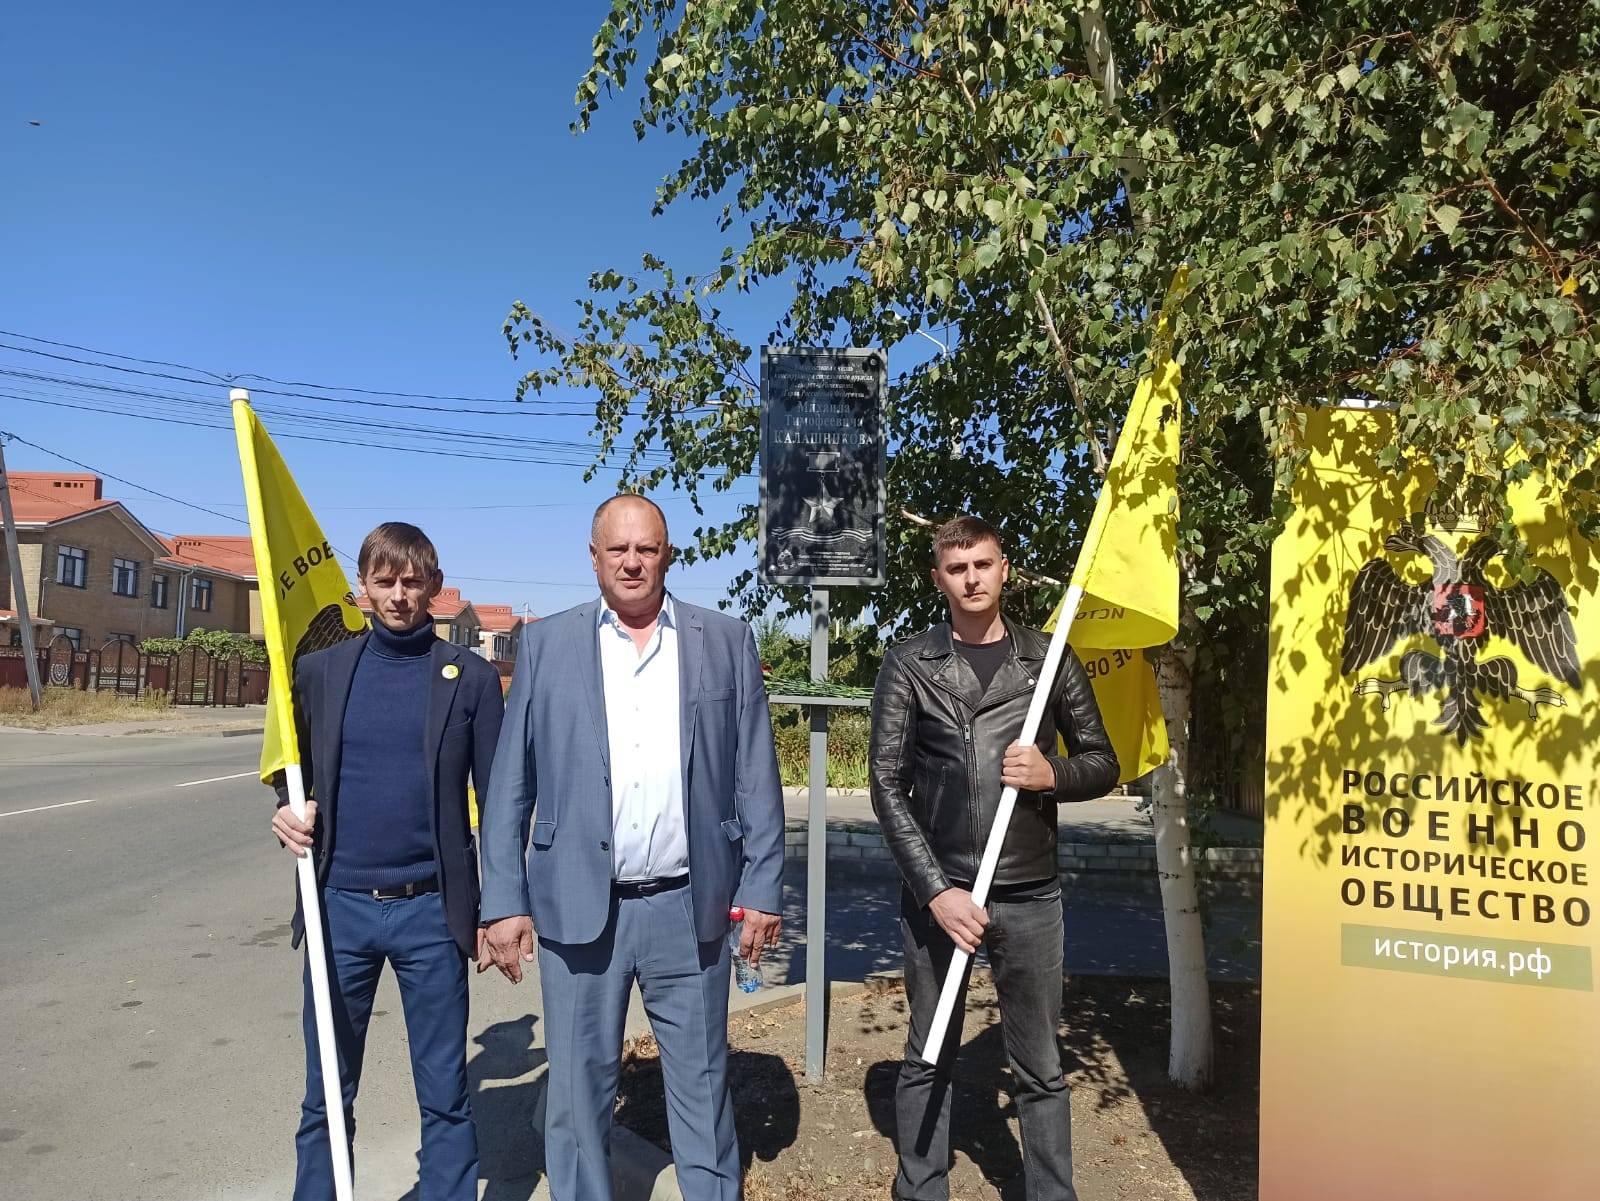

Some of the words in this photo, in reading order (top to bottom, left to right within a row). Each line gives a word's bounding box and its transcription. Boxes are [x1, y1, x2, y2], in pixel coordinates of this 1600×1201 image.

[774, 430, 873, 445] КАЛАШНИКОВА
[1343, 769, 1583, 811] РОССИЙСКОЕ
[1342, 804, 1586, 852] ВОЕННО
[1341, 845, 1588, 886] ИСТОРИЧЕСКОЕ
[1341, 877, 1591, 927] ОБЩЕСТВО
[1374, 938, 1552, 979] история.рф
